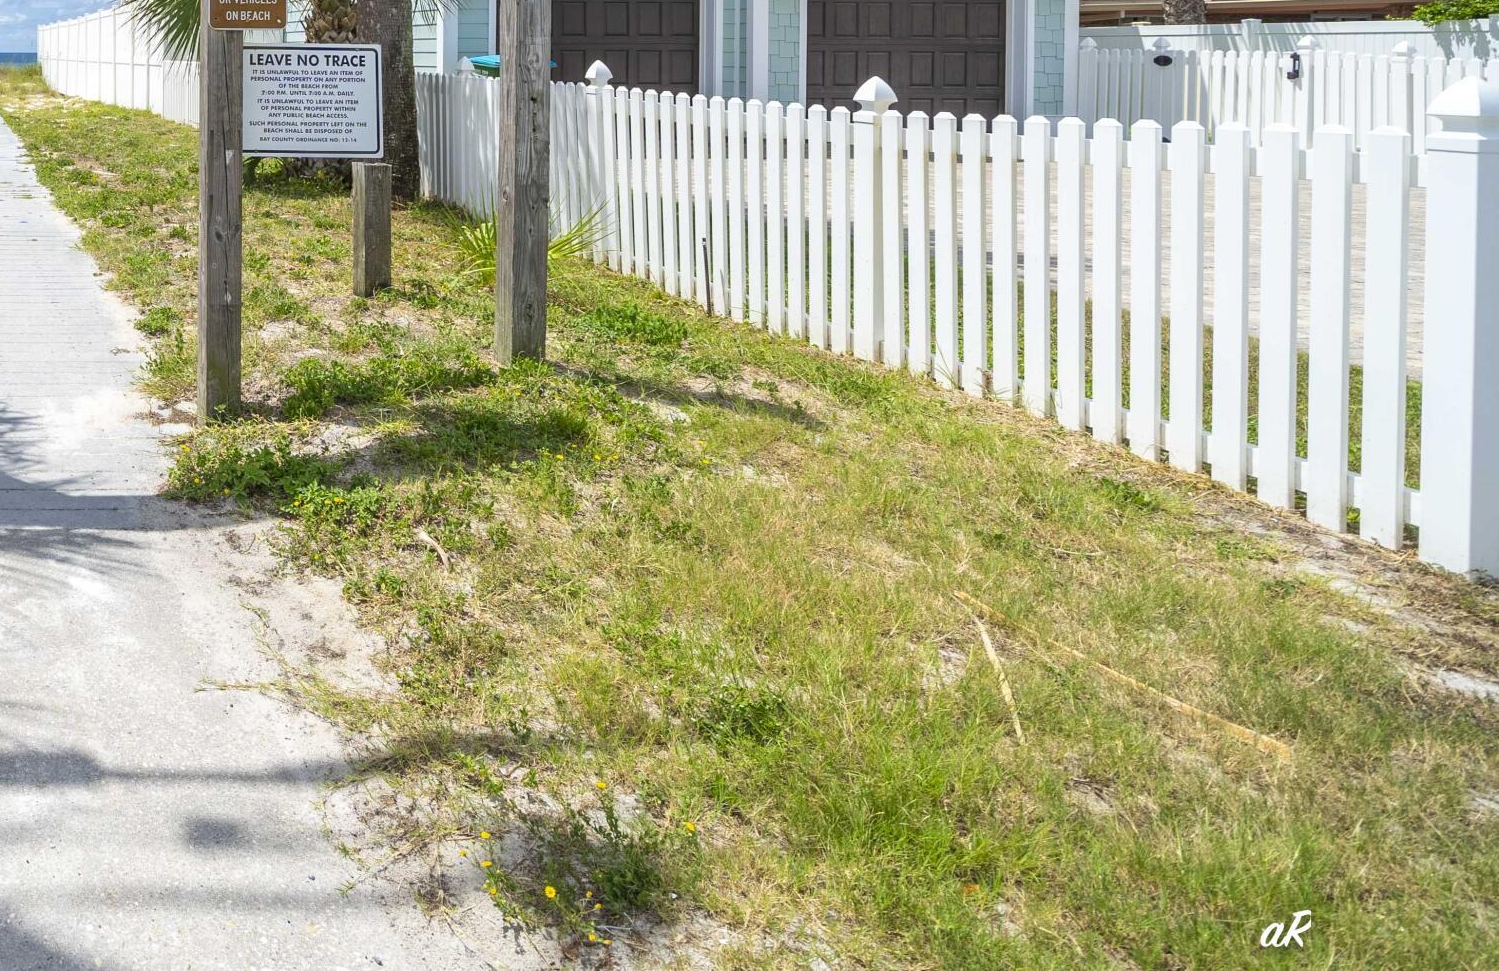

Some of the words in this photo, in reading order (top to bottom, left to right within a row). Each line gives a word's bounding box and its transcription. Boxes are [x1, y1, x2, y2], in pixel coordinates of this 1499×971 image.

[226, 11, 238, 20] ON
[241, 11, 270, 20] BEACH
[250, 54, 291, 66] LEAVE
[297, 54, 319, 66] NO
[324, 55, 366, 66] TRACE
